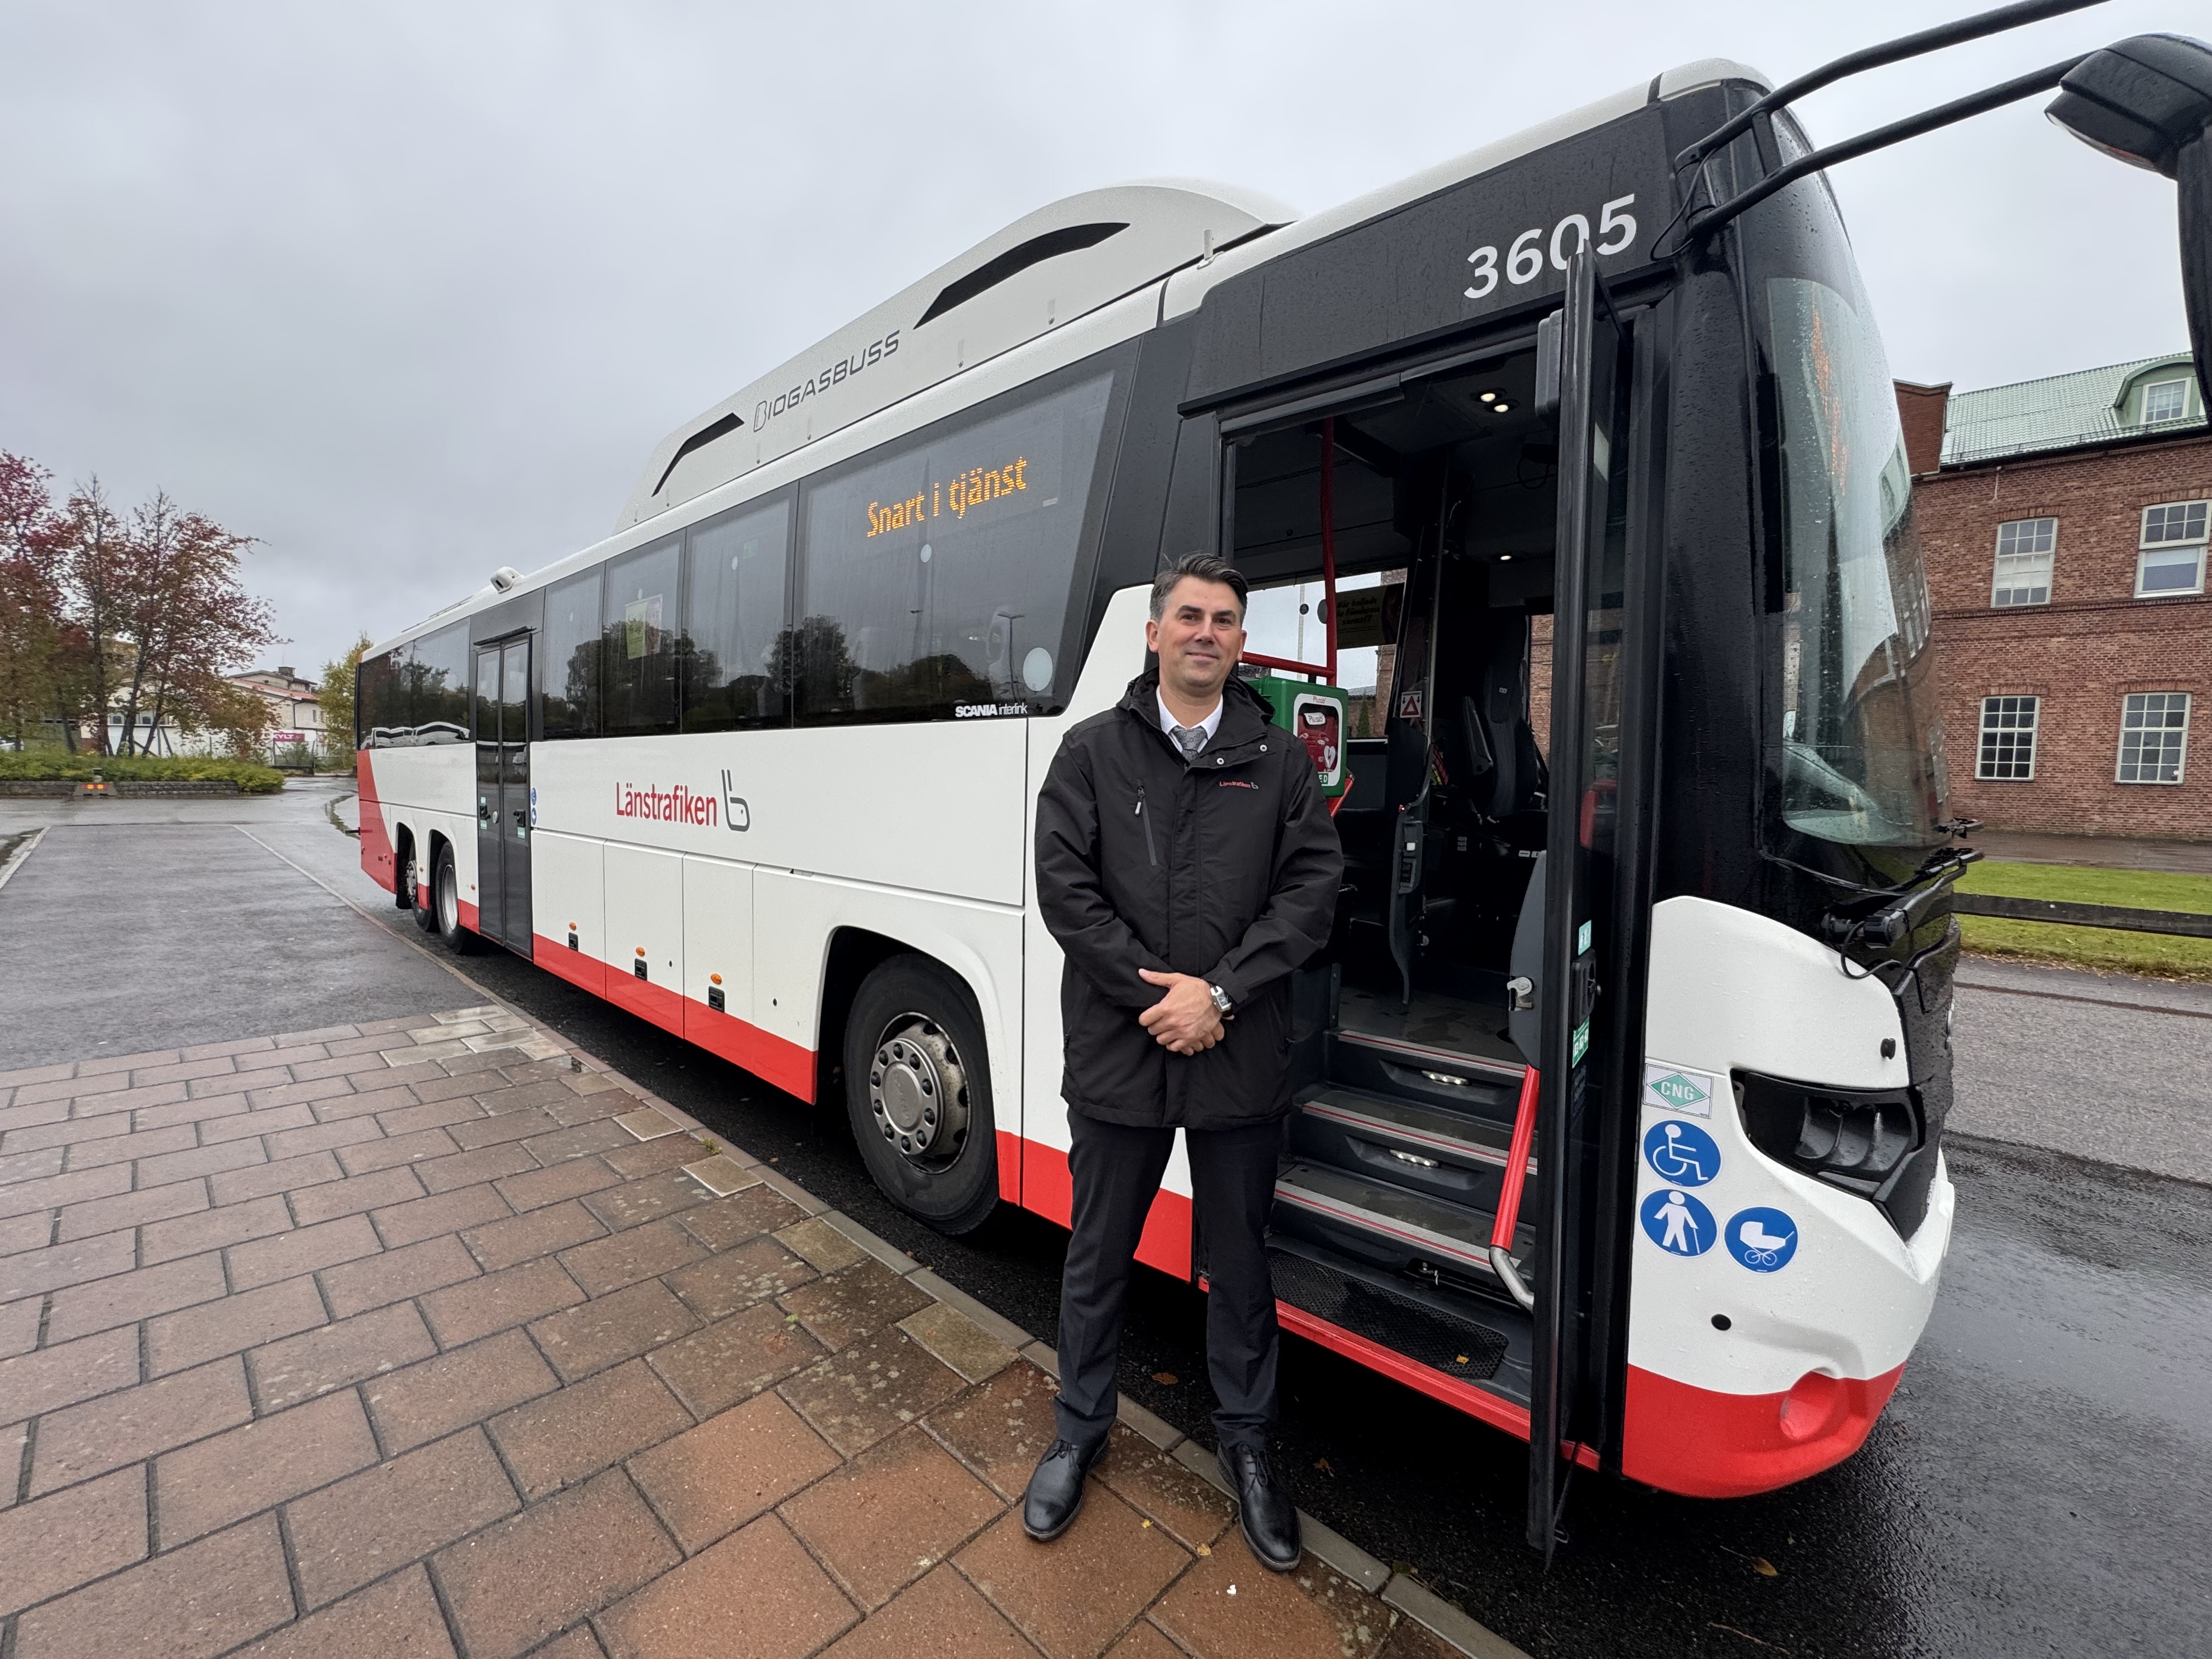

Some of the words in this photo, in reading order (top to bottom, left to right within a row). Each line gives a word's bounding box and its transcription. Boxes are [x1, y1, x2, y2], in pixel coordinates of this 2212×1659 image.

[1464, 194, 1637, 298] 3605
[753, 329, 900, 433] BIOGASBUSS
[867, 492, 926, 538] Snart
[933, 482, 940, 517] i
[949, 456, 1027, 520] tjänst
[955, 704, 997, 718] SCANIA
[998, 702, 1028, 715] interlink
[617, 782, 717, 827] Länstrafiken
[1661, 1081, 1694, 1101] CNG
